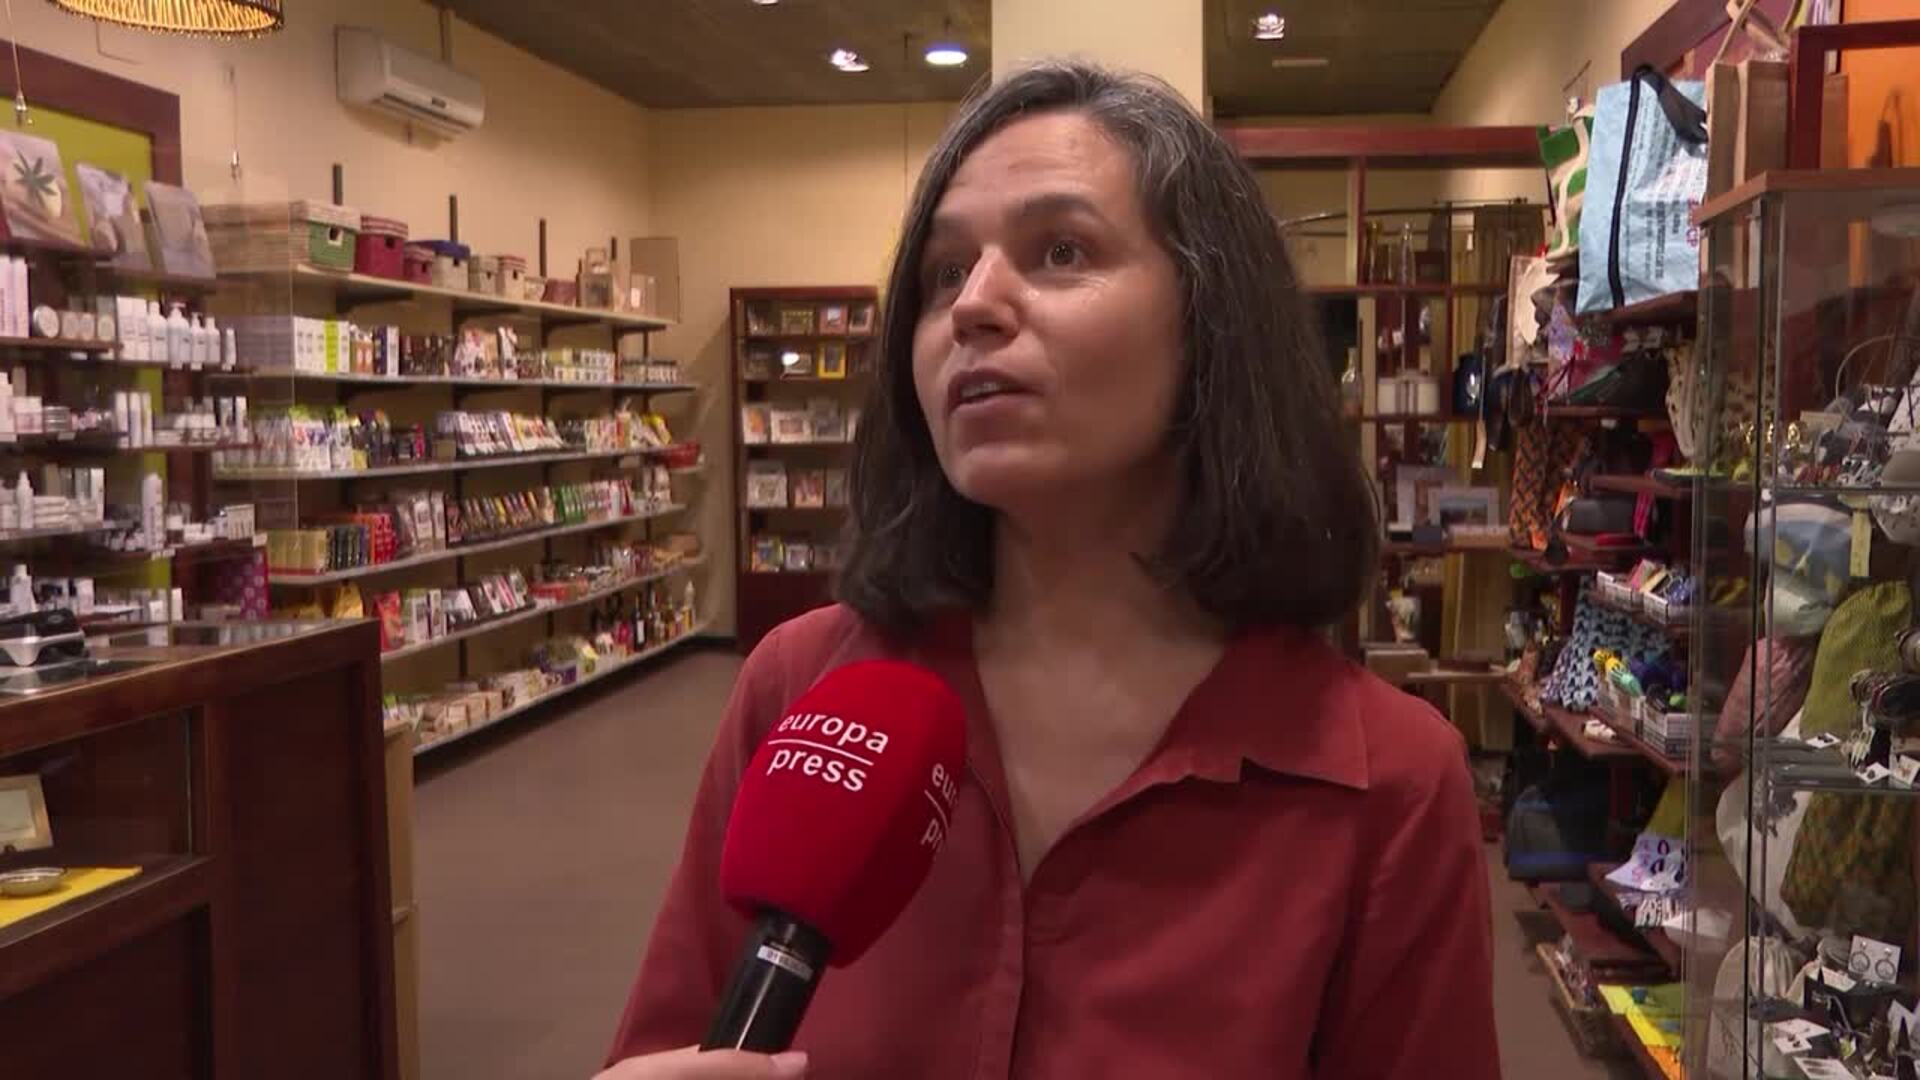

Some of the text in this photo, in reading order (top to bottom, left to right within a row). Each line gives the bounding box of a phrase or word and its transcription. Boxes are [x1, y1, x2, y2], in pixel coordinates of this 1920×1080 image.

[777, 713, 889, 754] europa
[766, 749, 867, 792] press
[931, 762, 958, 807] eur
[921, 818, 943, 853] pr
